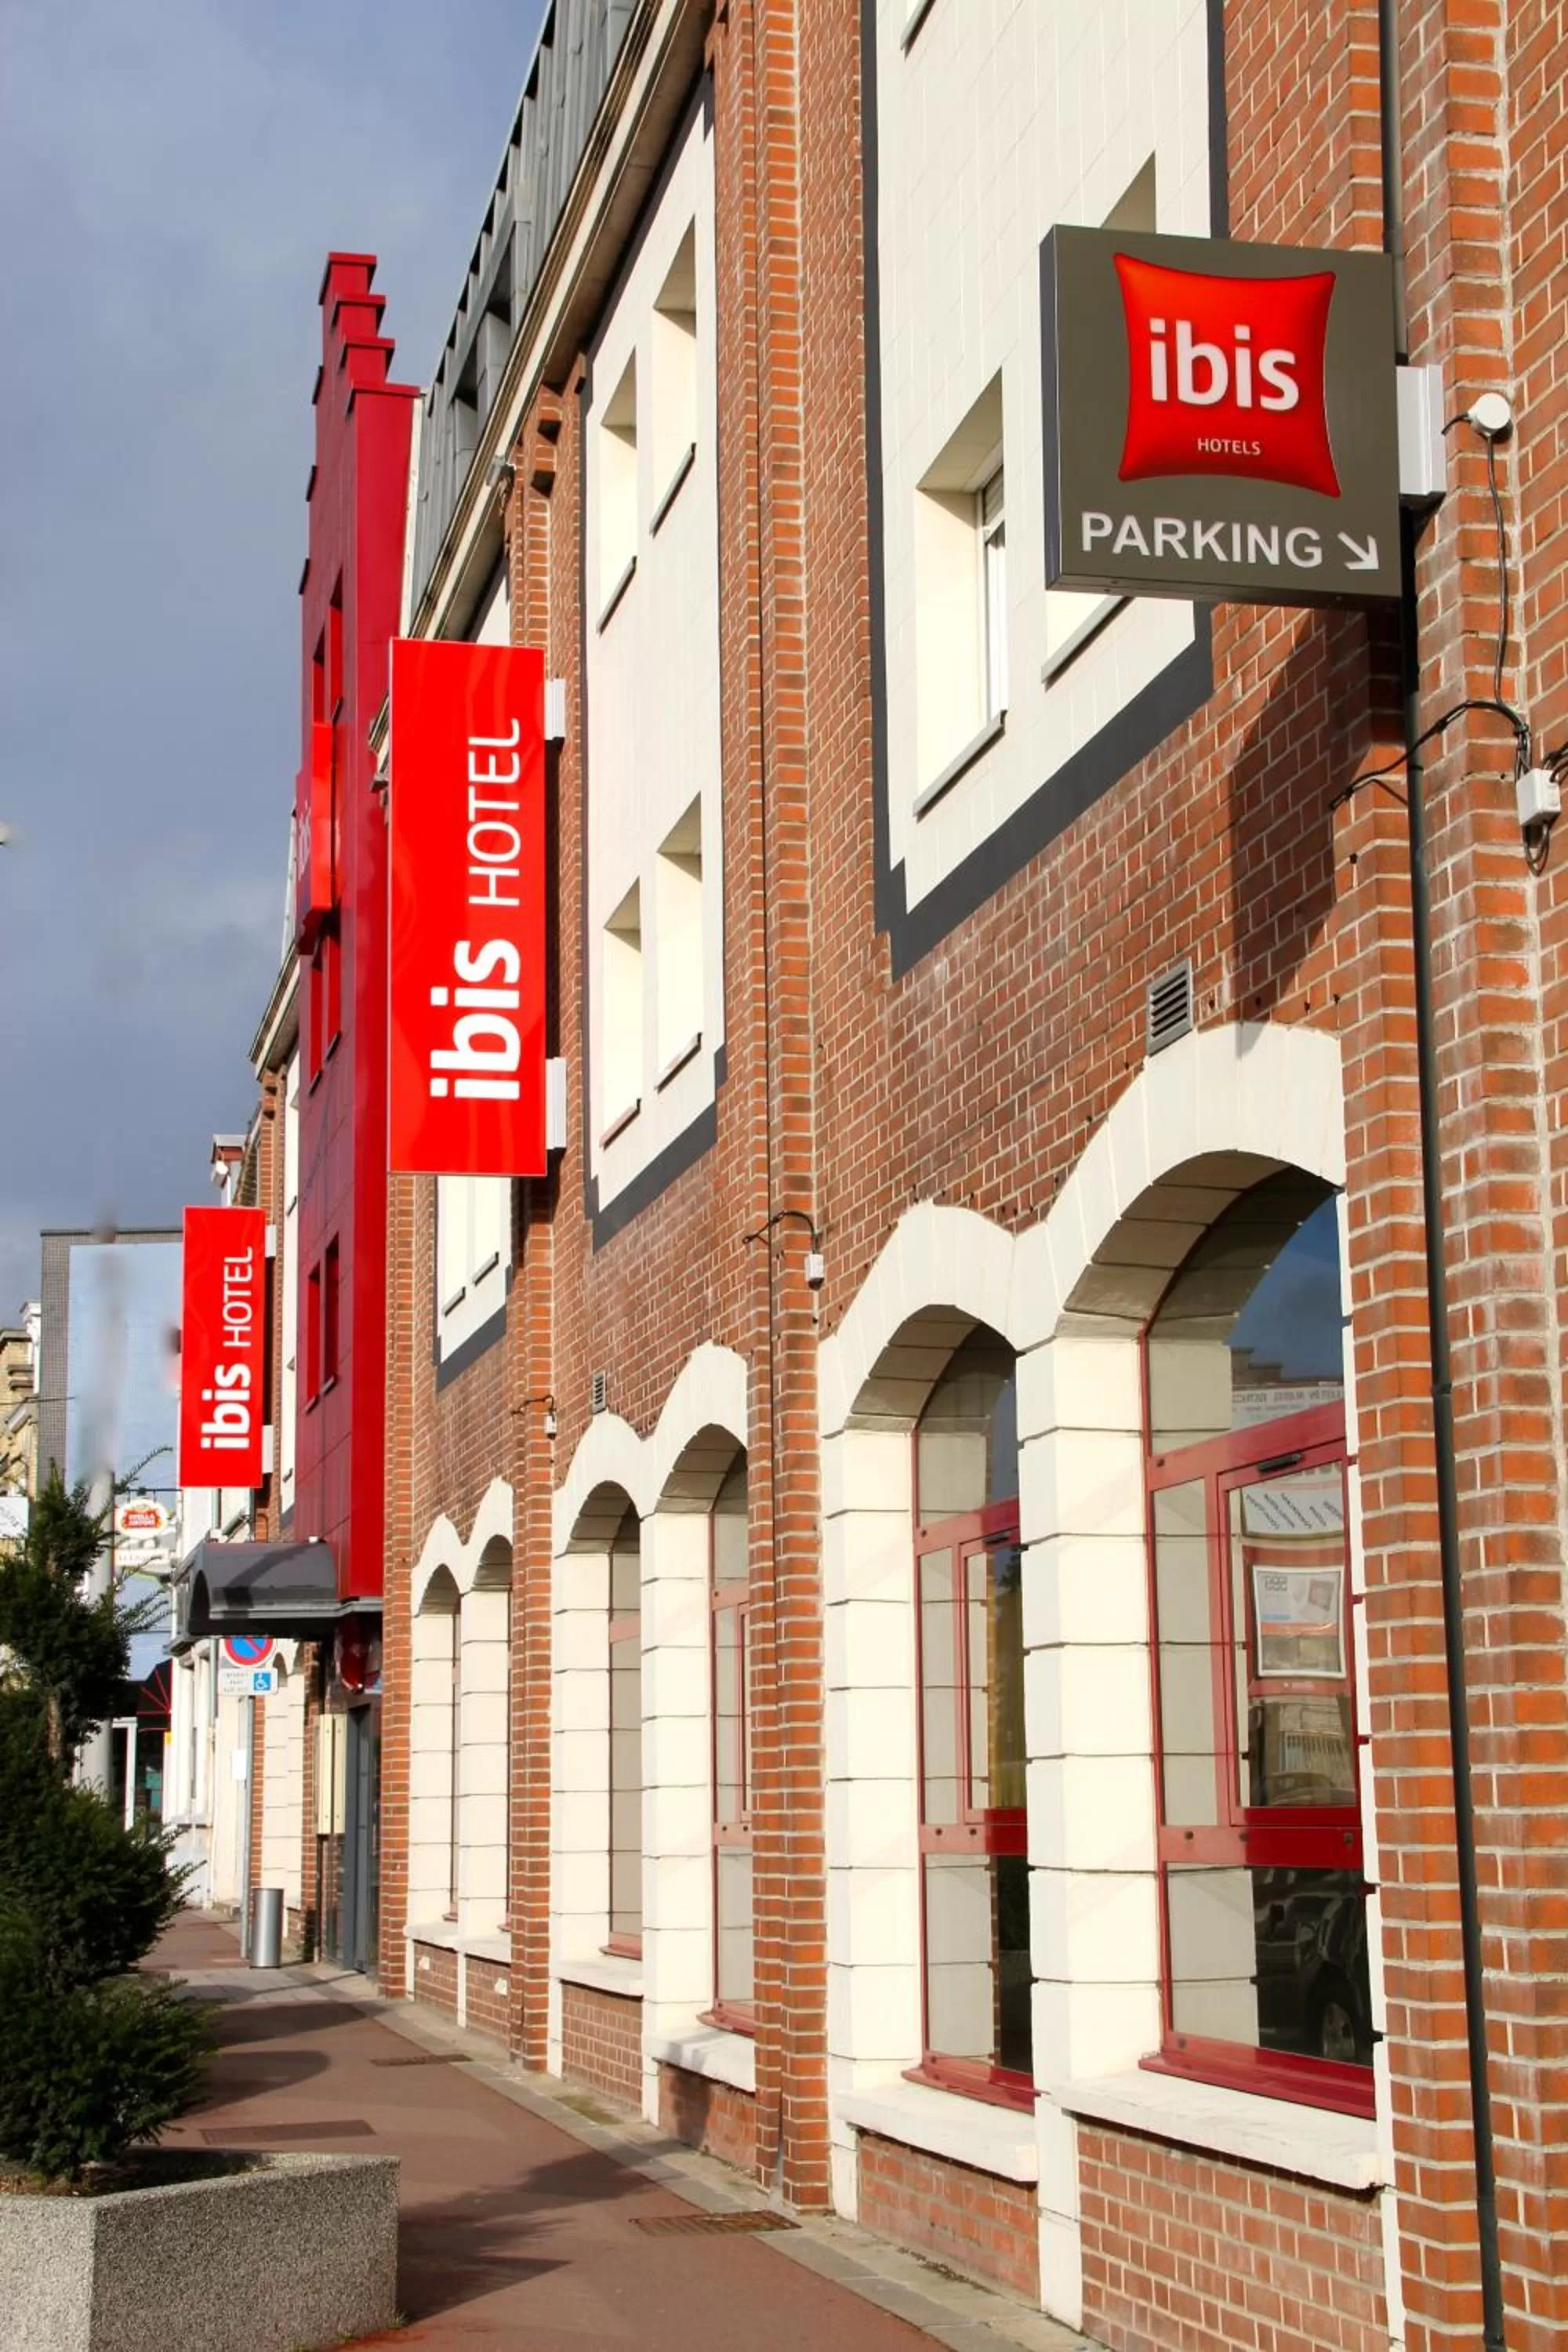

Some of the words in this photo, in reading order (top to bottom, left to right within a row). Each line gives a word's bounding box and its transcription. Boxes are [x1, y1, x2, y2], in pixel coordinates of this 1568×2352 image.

[1149, 318, 1300, 412] ibis
[1196, 437, 1262, 456] HOTELS
[1080, 510, 1323, 569] PARKING
[466, 717, 521, 907] HOTEL
[430, 938, 521, 1101] ibis
[222, 1247, 253, 1348] HOTEL
[200, 1362, 252, 1449] ibis
